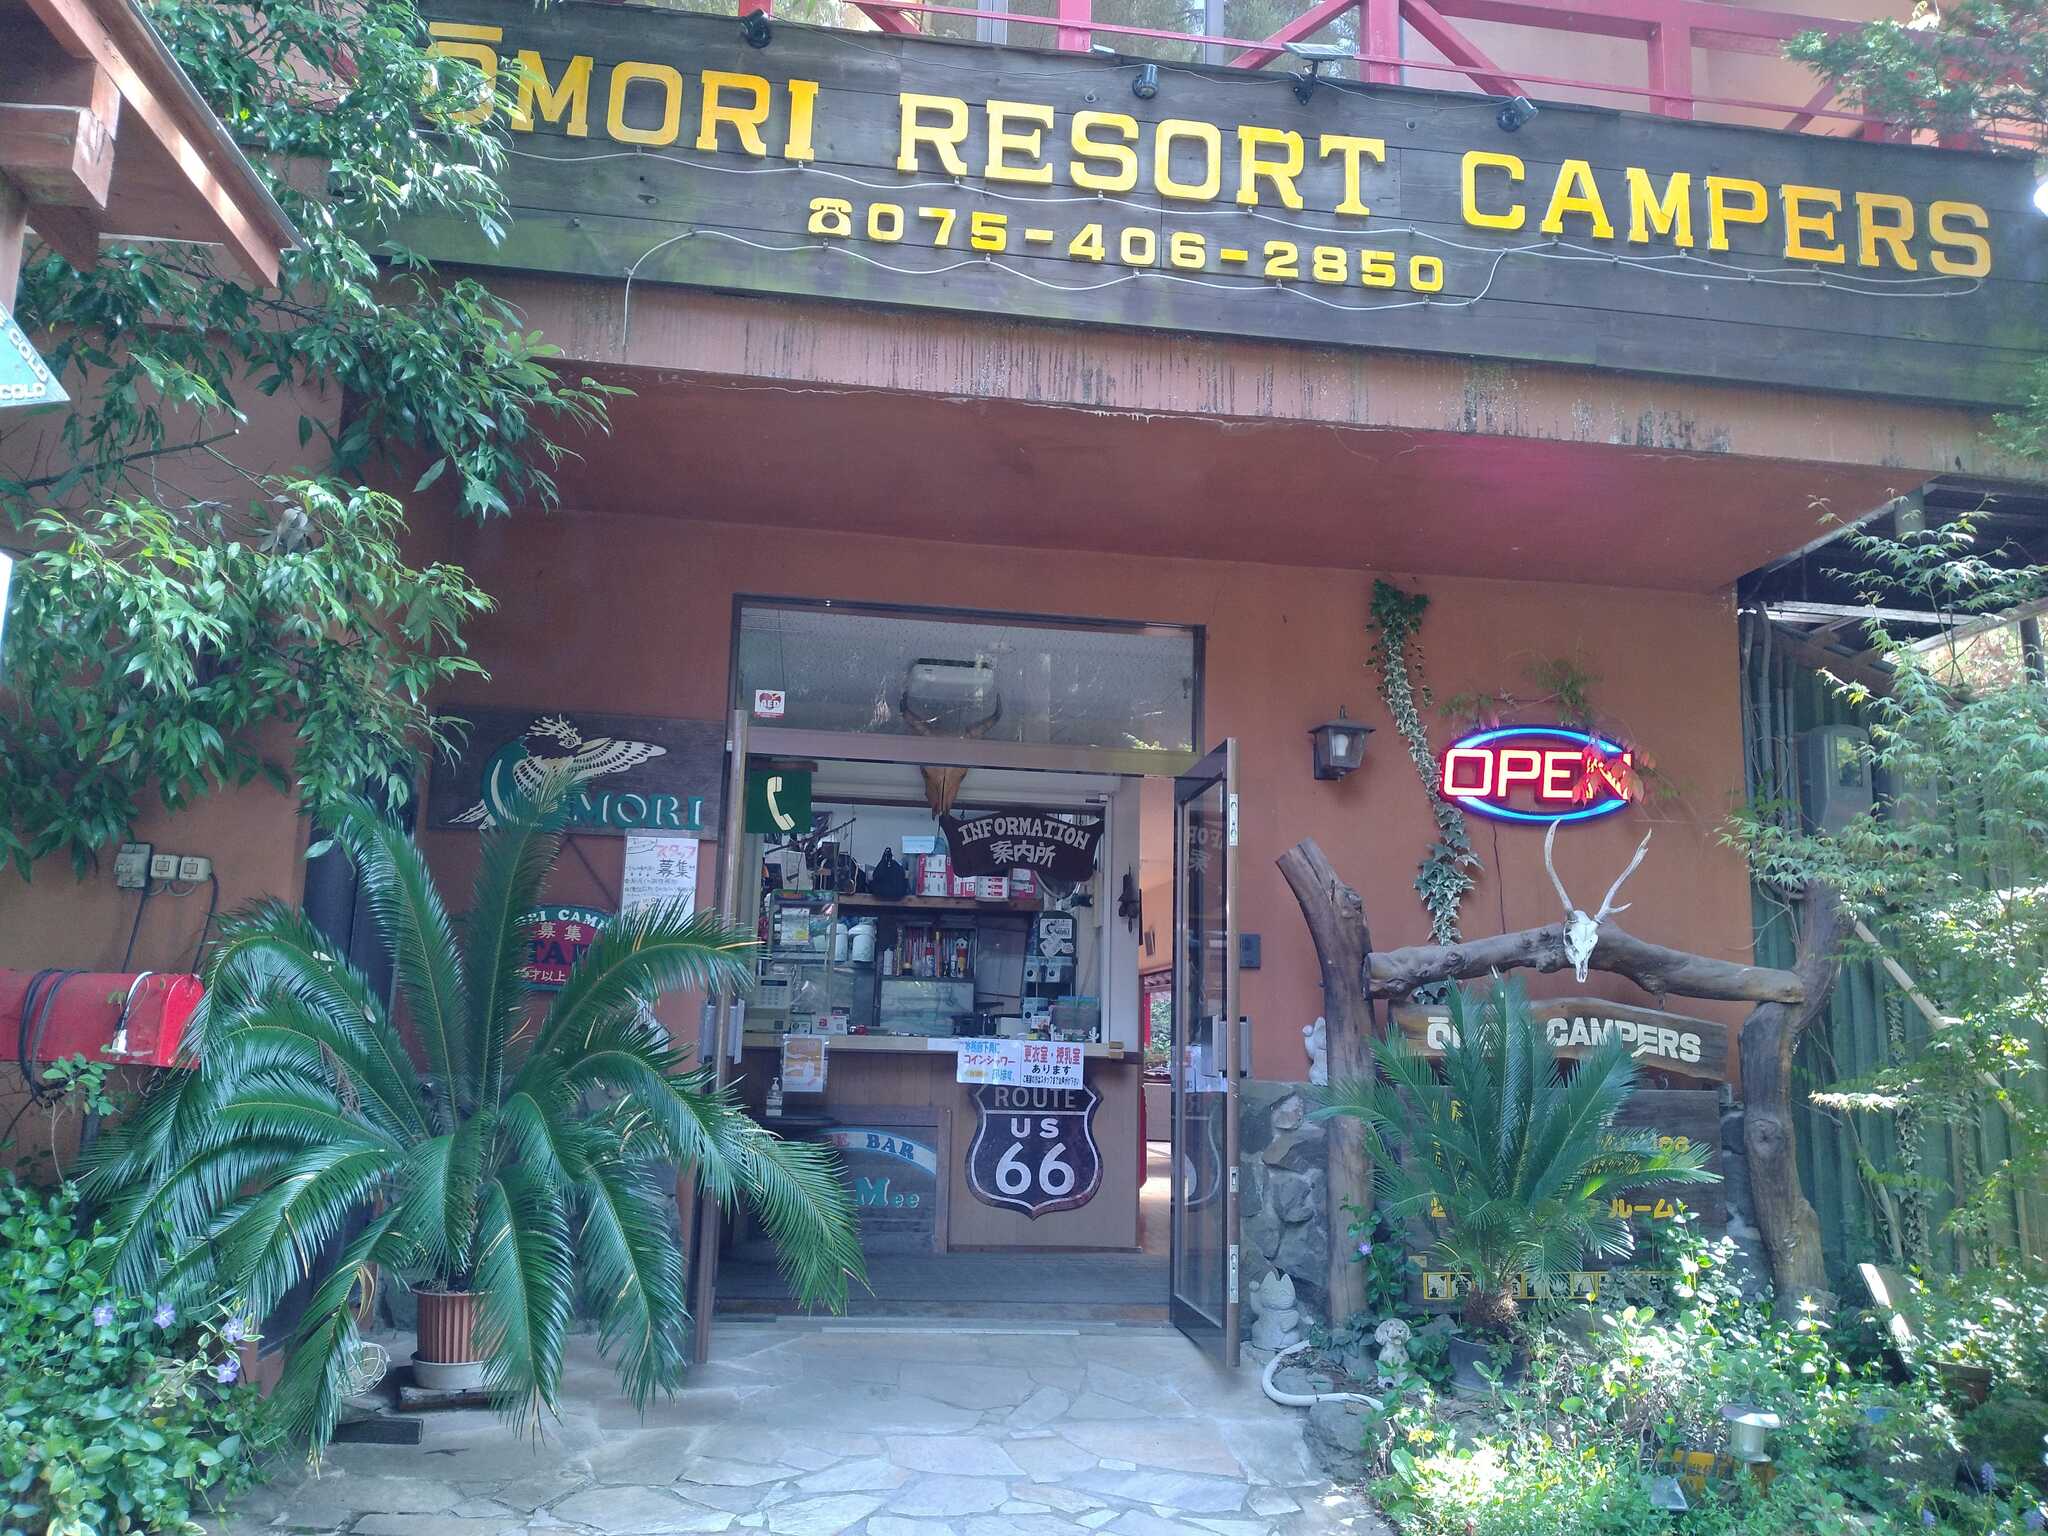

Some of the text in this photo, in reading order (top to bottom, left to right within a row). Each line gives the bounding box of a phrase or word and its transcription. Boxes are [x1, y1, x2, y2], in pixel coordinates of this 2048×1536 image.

[896, 92, 1387, 217] RESORT
[1461, 150, 1991, 279] CAMPERS
[867, 203, 1444, 293] 075-406-2850
[958, 817, 1090, 850] INFORMATION
[990, 840, 1056, 868] 案内所
[1031, 1064, 1072, 1075] あります
[994, 1087, 1077, 1109] ROUTE
[1010, 1117, 1060, 1139] US
[866, 1133, 914, 1160] BAR
[995, 1142, 1075, 1196] 66
